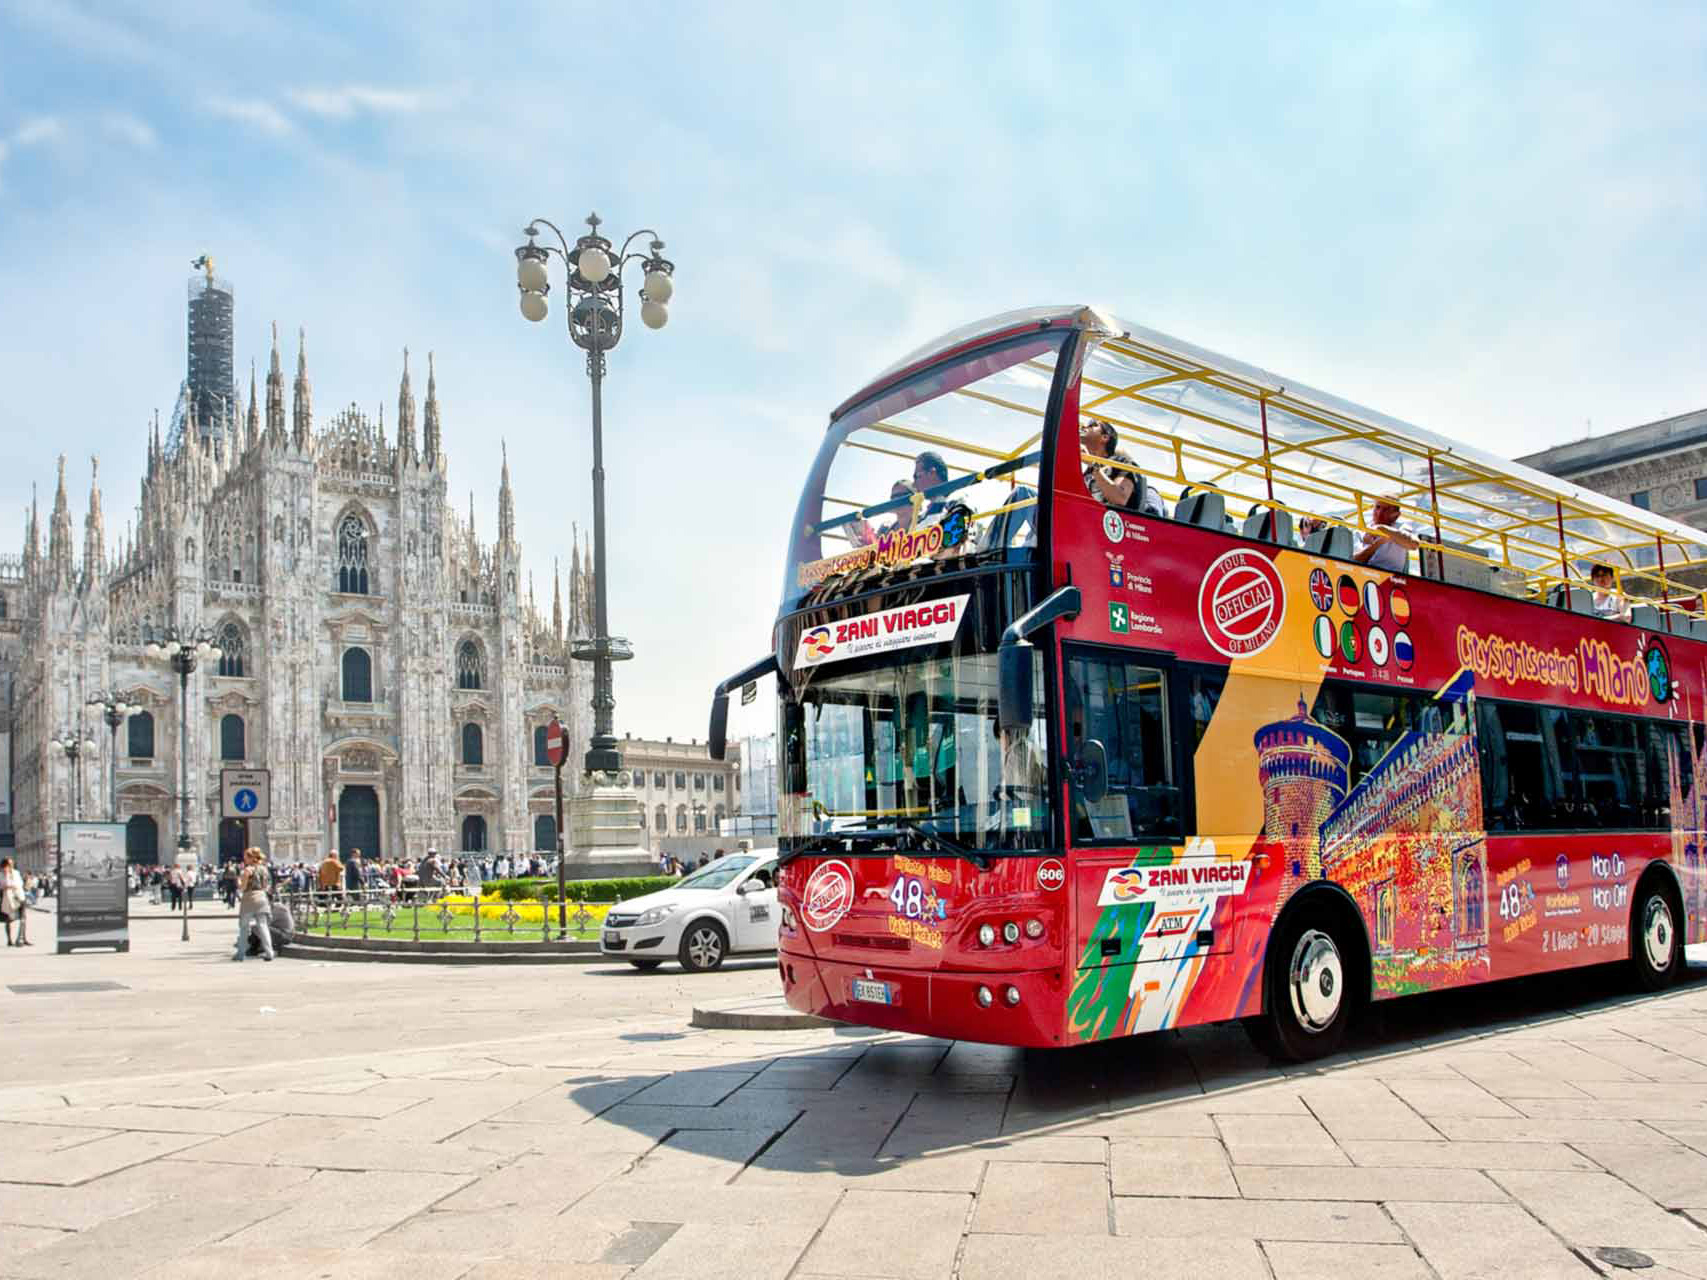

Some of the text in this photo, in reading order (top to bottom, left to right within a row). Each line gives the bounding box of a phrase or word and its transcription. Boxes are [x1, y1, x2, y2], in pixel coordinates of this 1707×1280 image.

[874, 523, 943, 563] Milano
[1219, 554, 1247, 575] TOUR
[1217, 582, 1271, 622] OFFICIAL
[836, 602, 956, 644] ZANI VIAGGI
[1229, 619, 1277, 653] OF MILANO
[1579, 637, 1650, 706] Milano
[1040, 868, 1063, 881] 606
[1148, 865, 1245, 887] ZANI VIAGGI
[1591, 852, 1626, 880] Hop On
[890, 875, 922, 918] 48
[1499, 883, 1521, 921] 48
[1592, 887, 1612, 912] Hop
[1613, 883, 1628, 908] Off
[1161, 917, 1184, 930] ATM
[1541, 929, 1550, 953] 2
